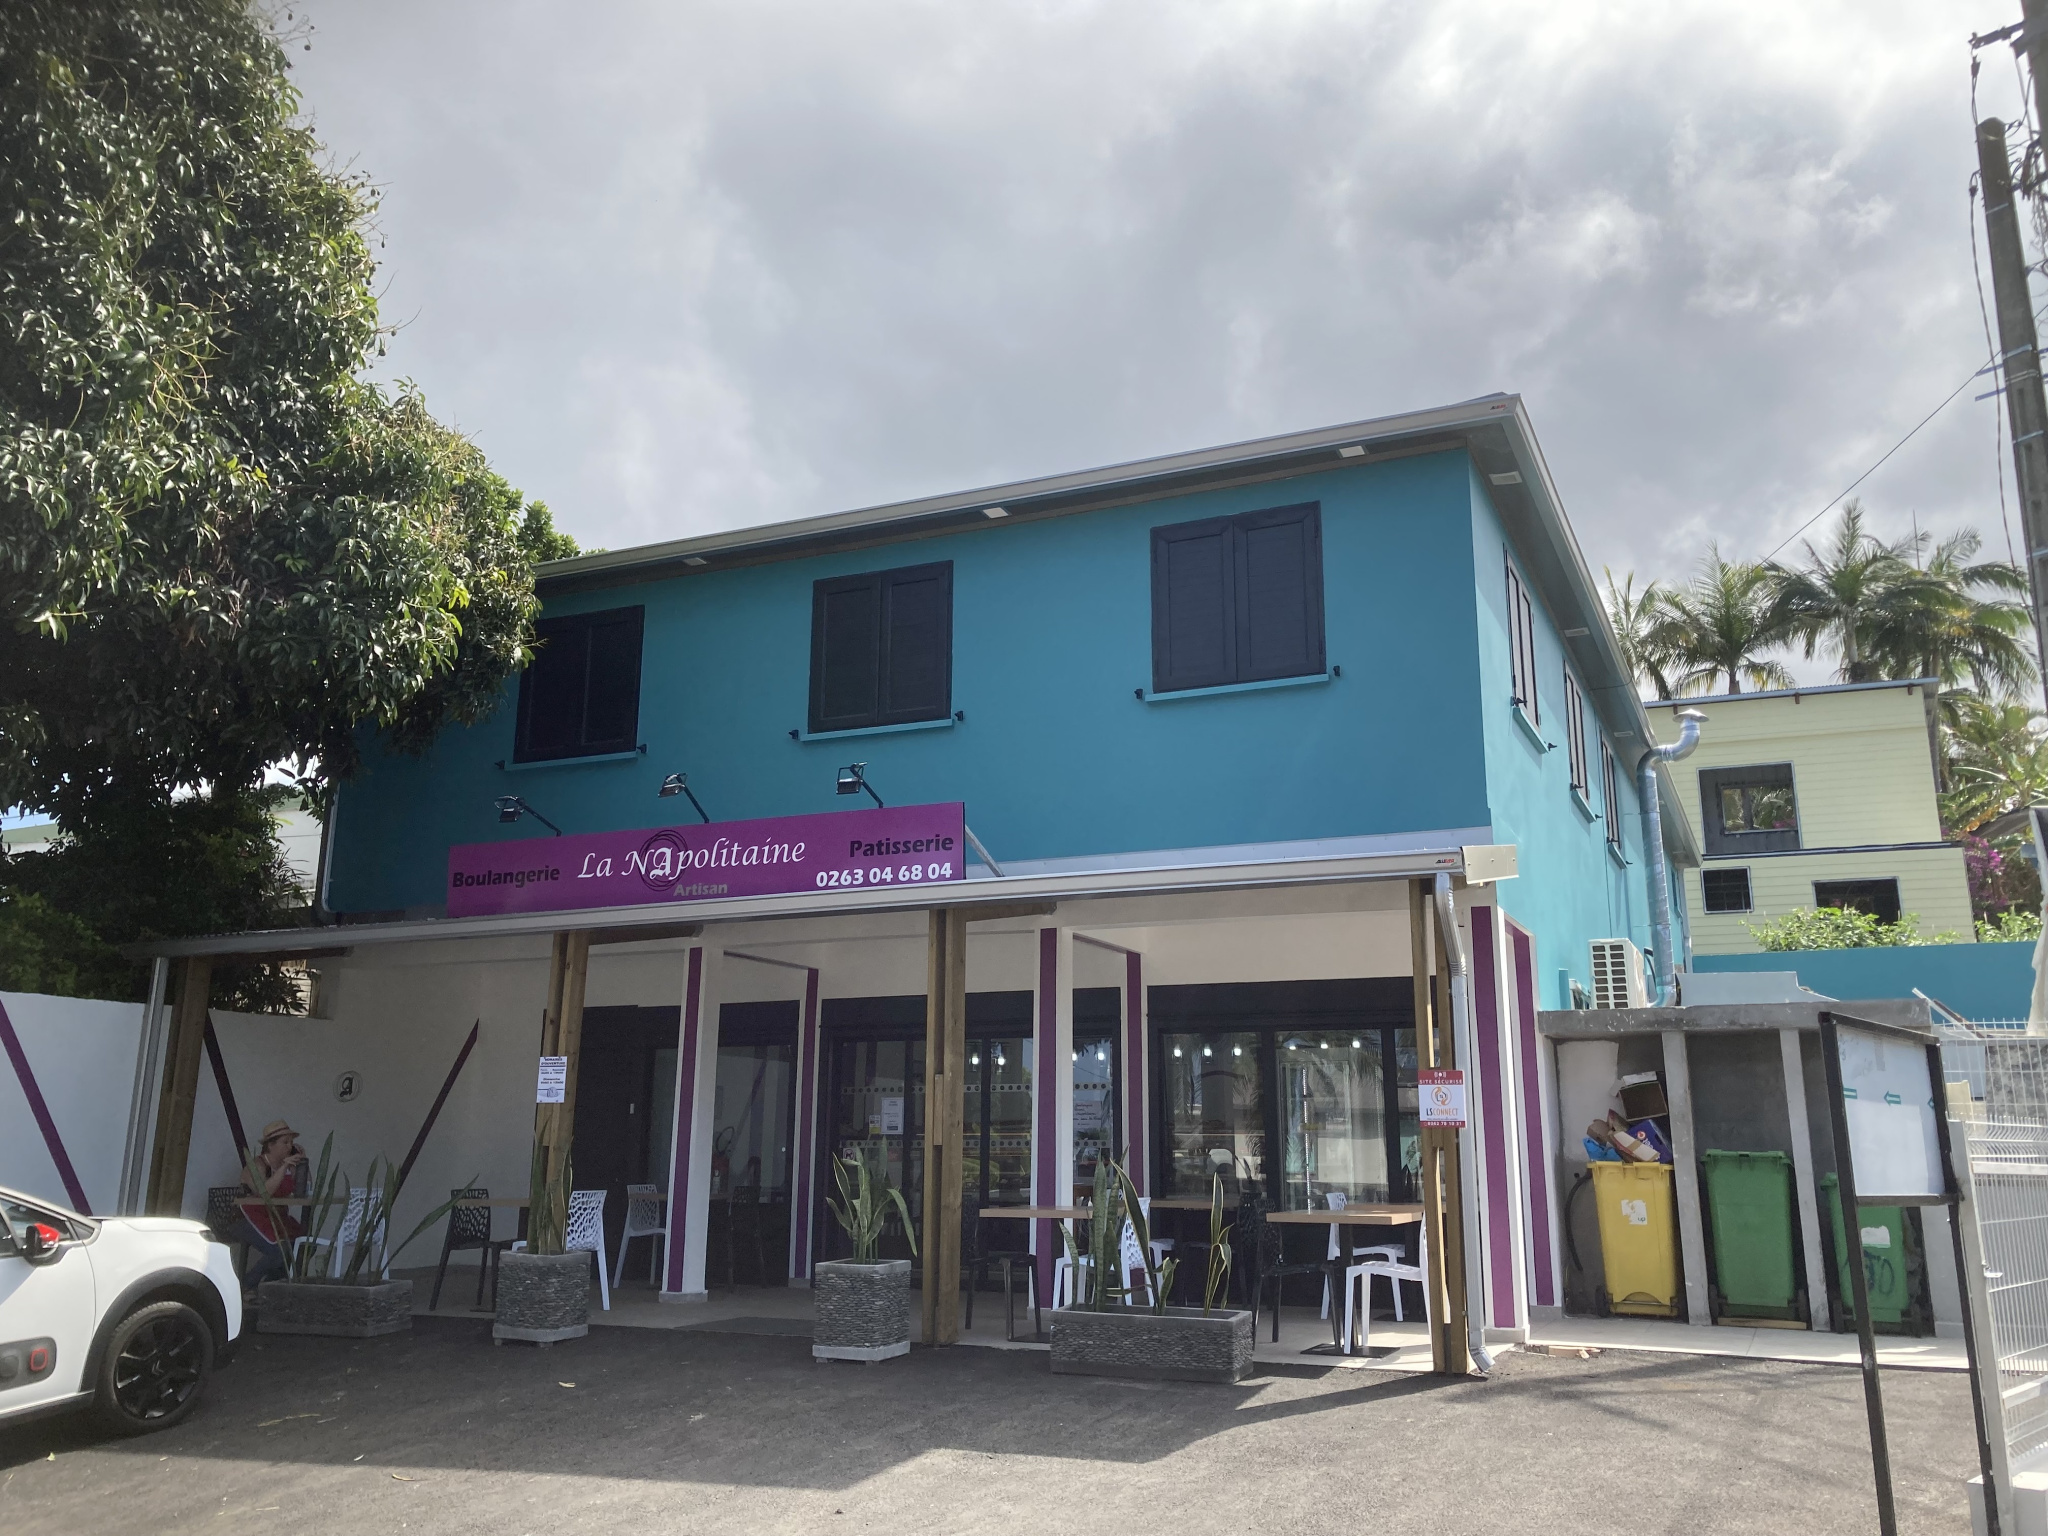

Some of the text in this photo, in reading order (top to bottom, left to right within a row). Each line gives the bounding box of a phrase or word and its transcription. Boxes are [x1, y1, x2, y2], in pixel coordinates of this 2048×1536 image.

[850, 834, 954, 858] Patisserie
[452, 865, 560, 888] Boulangerie
[577, 853, 613, 879] La
[816, 862, 953, 887] 0263 04 68 04
[673, 882, 728, 897] Artisan
